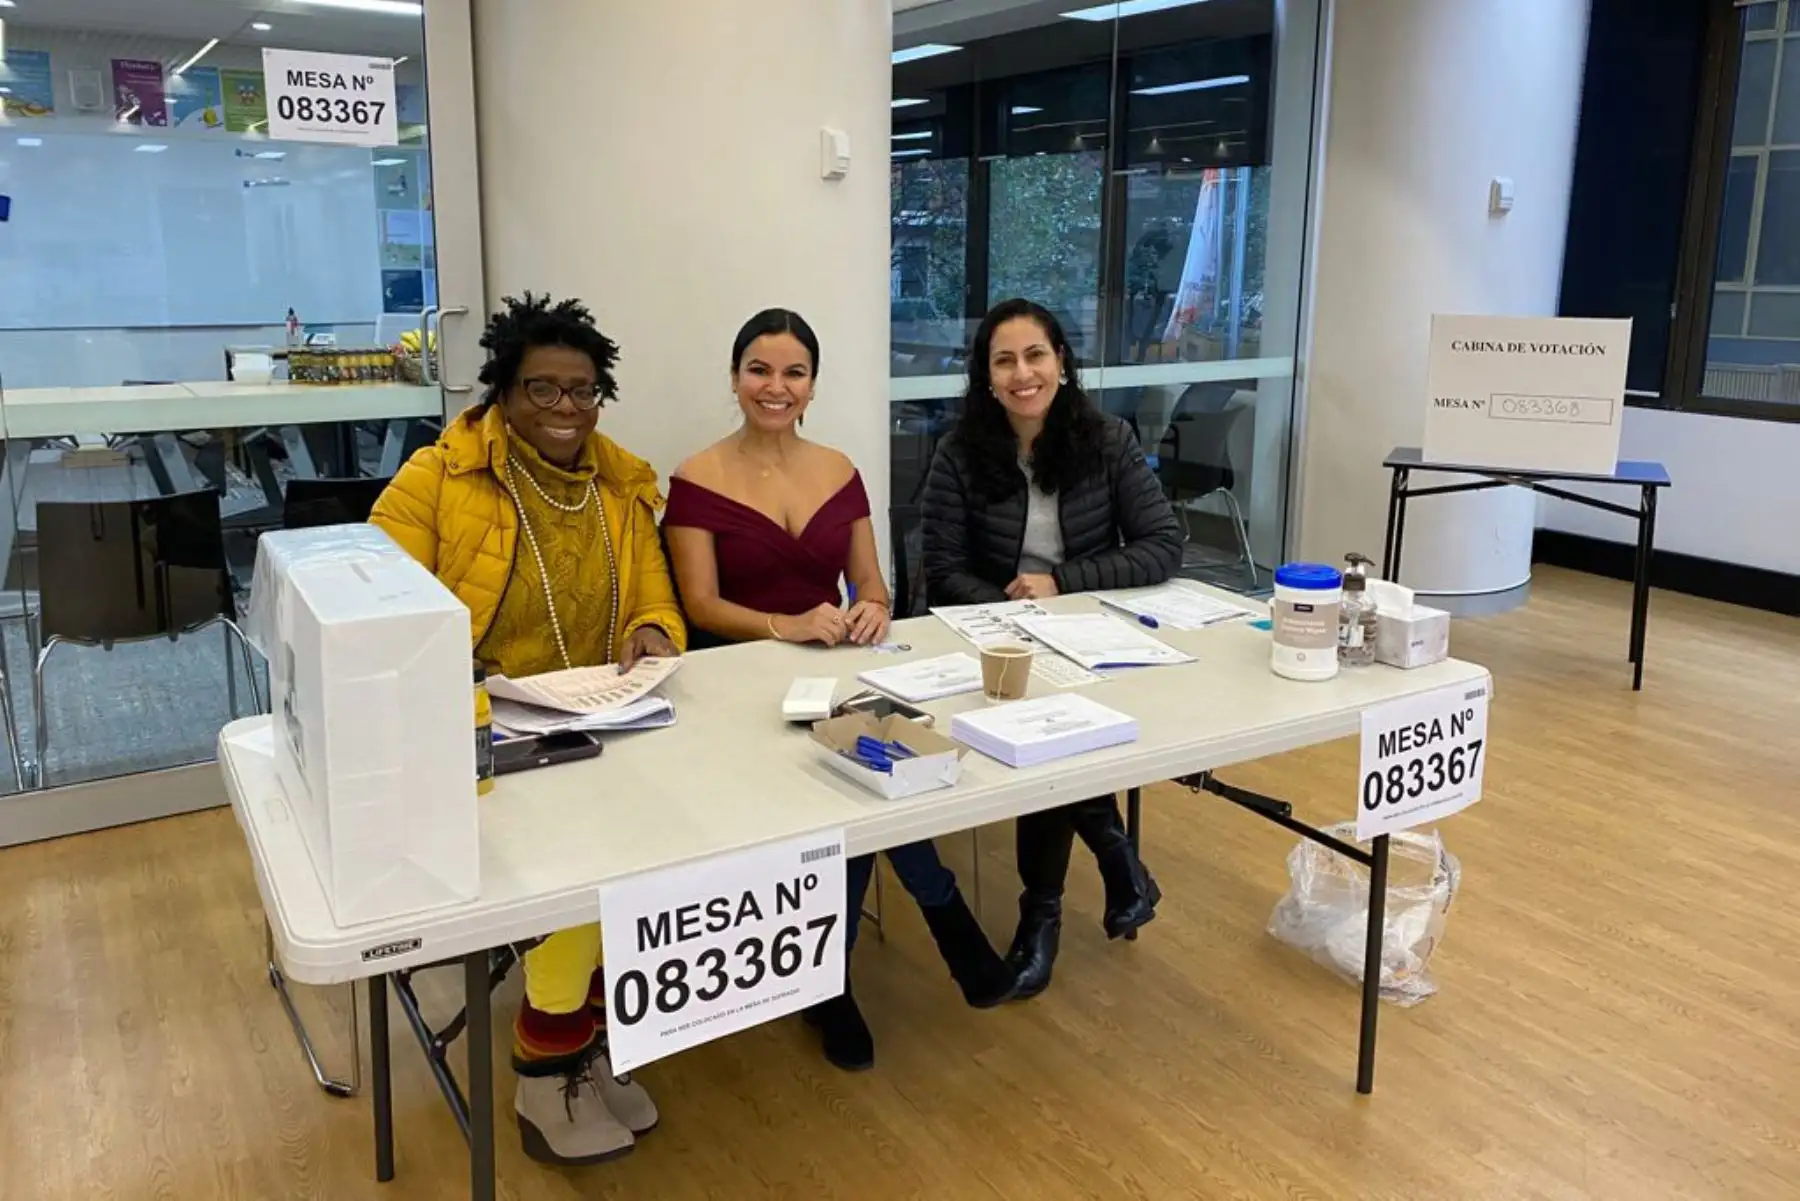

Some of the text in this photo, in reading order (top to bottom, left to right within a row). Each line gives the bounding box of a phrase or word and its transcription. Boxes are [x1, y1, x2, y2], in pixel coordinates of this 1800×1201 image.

[287, 69, 347, 91] MESA
[277, 95, 386, 126] 083367
[1451, 340, 1607, 355] CABINA DE VOTACIÓN
[1433, 397, 1470, 409] MESA
[1378, 718, 1444, 759] MESA
[1363, 739, 1483, 811] 083367
[636, 890, 764, 953] MESA
[614, 913, 838, 1026] 083367
